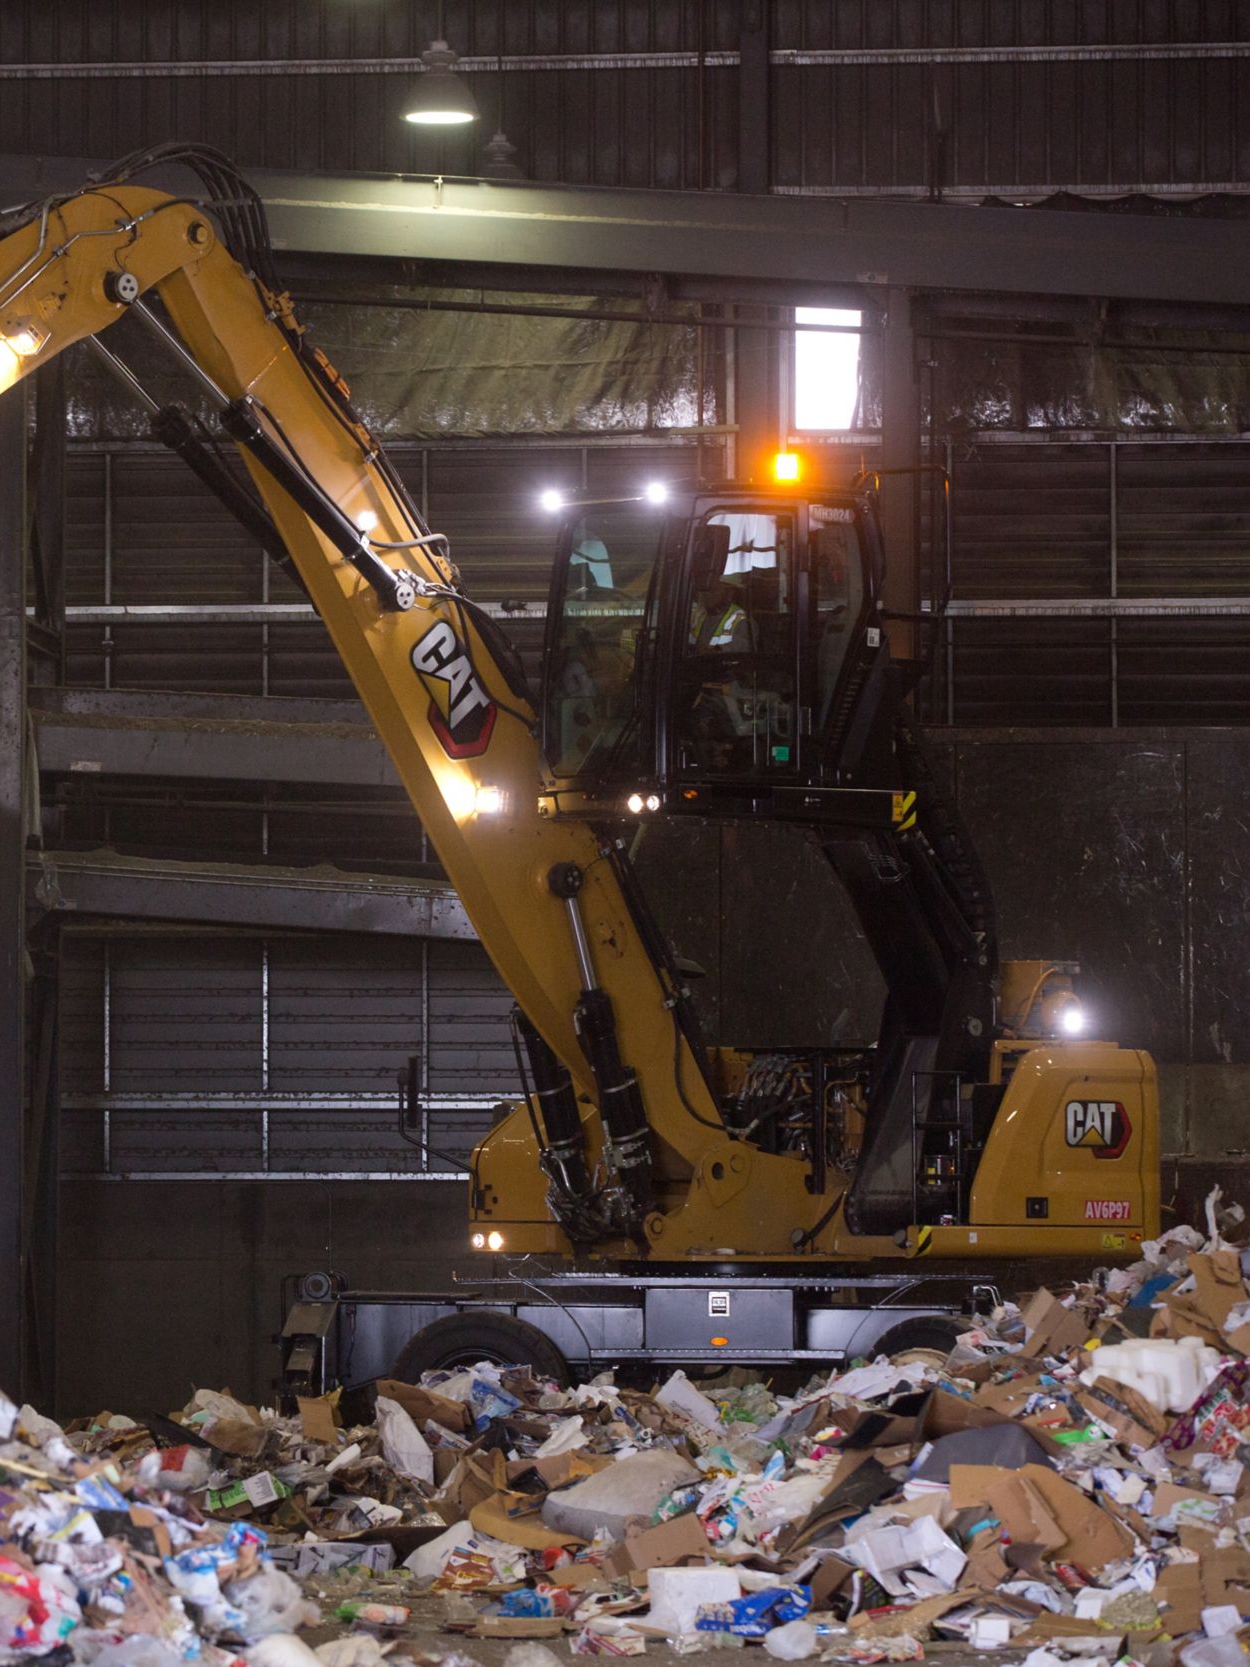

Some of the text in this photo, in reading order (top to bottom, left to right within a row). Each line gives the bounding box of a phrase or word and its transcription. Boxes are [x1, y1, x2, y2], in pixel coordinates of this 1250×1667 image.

[812, 508, 850, 521] MH3024
[412, 621, 491, 730] CAT
[1066, 1102, 1116, 1146] CAT
[1085, 1201, 1130, 1219] AV6P97
